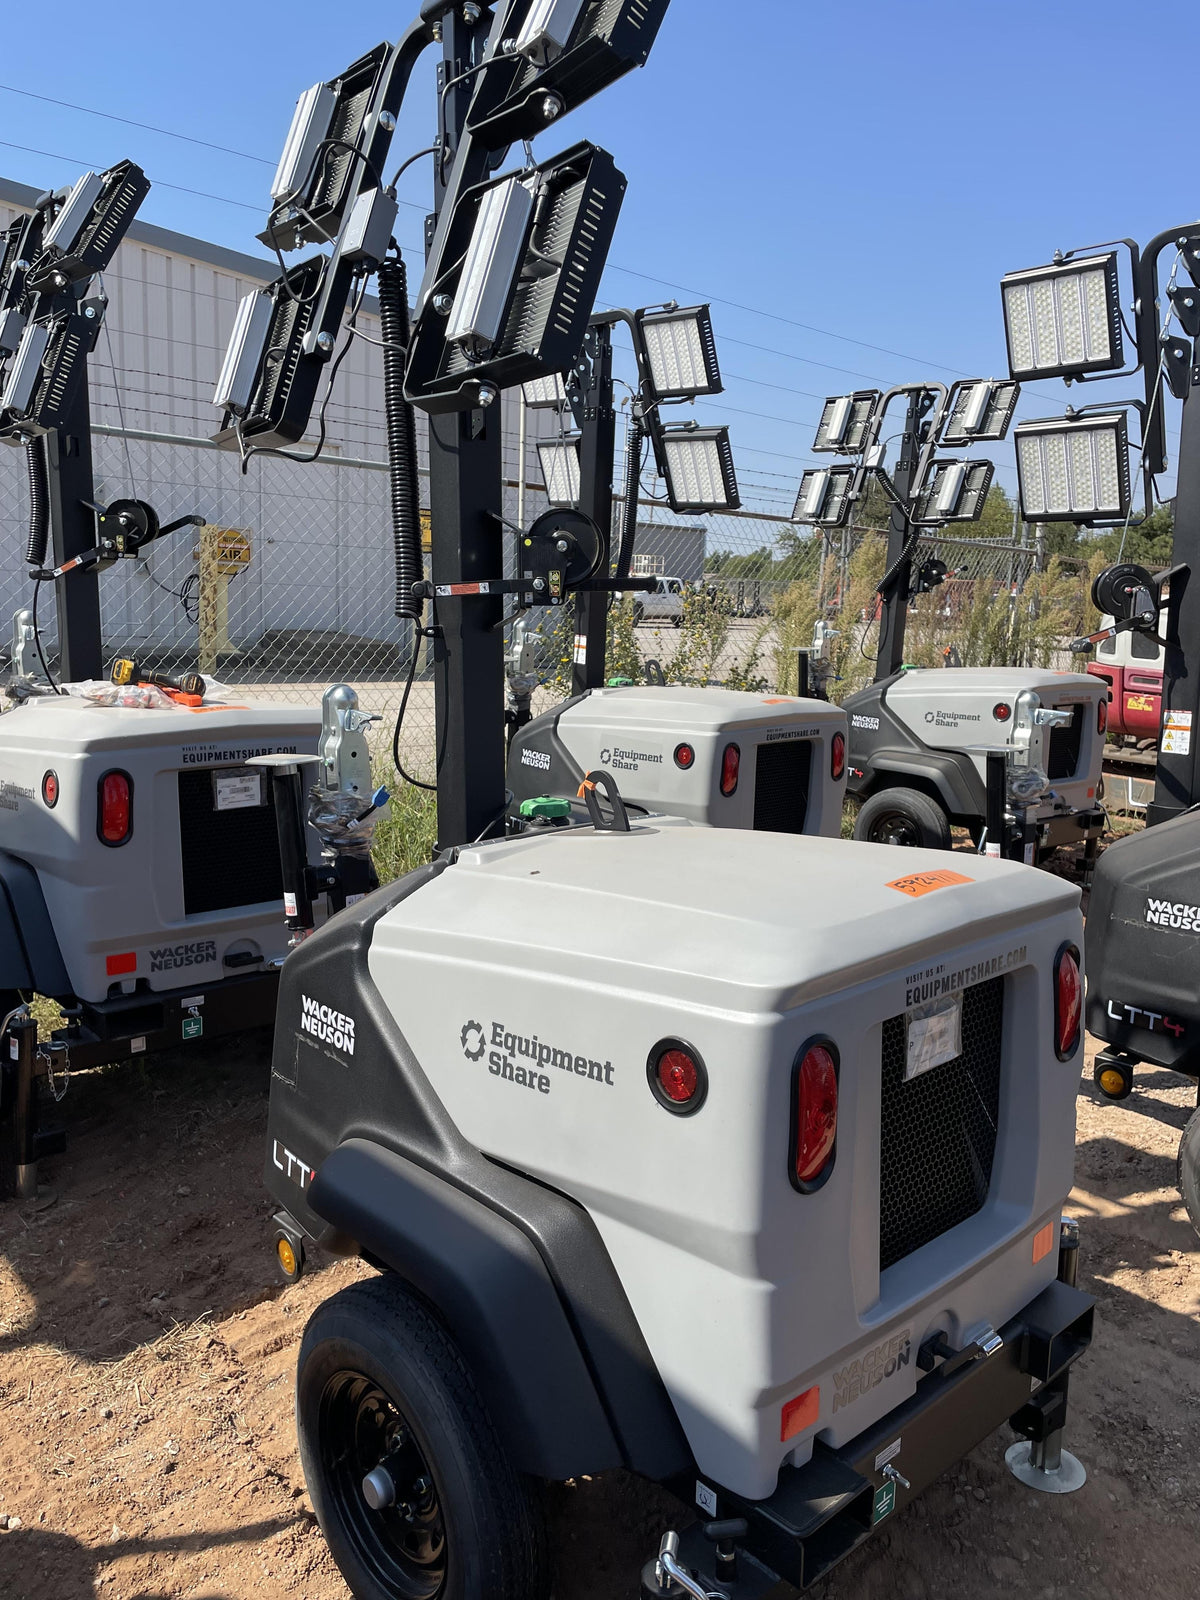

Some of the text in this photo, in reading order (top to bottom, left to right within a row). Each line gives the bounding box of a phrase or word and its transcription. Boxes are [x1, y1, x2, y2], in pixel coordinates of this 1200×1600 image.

[220, 549, 241, 559] AIR
[851, 720, 879, 730] NEUSON
[852, 714, 879, 724] WACKER
[935, 719, 959, 728] Share
[936, 711, 981, 721] Equipment
[182, 746, 297, 763] EQUIPMENTSHARECOM
[520, 756, 550, 770] NEUSON
[522, 748, 551, 763] WACKER
[613, 748, 663, 763] Equipment
[612, 758, 639, 771] Share
[1, 780, 35, 799] Equipment
[149, 940, 216, 961] WACKER
[150, 951, 217, 973] NEUSON
[905, 945, 1027, 1007] EQUIPMENTSHARE.COM
[905, 971, 923, 985] VISIT
[925, 968, 934, 978] US
[301, 994, 356, 1038] WACKER
[1107, 1000, 1185, 1037] LTT4
[301, 1012, 355, 1056] NEUSON
[490, 1021, 615, 1087] Equipment
[488, 1050, 551, 1095] Share
[272, 1138, 316, 1189] LTT
[832, 1328, 911, 1391] WACKER
[832, 1346, 911, 1415] NEUSON
